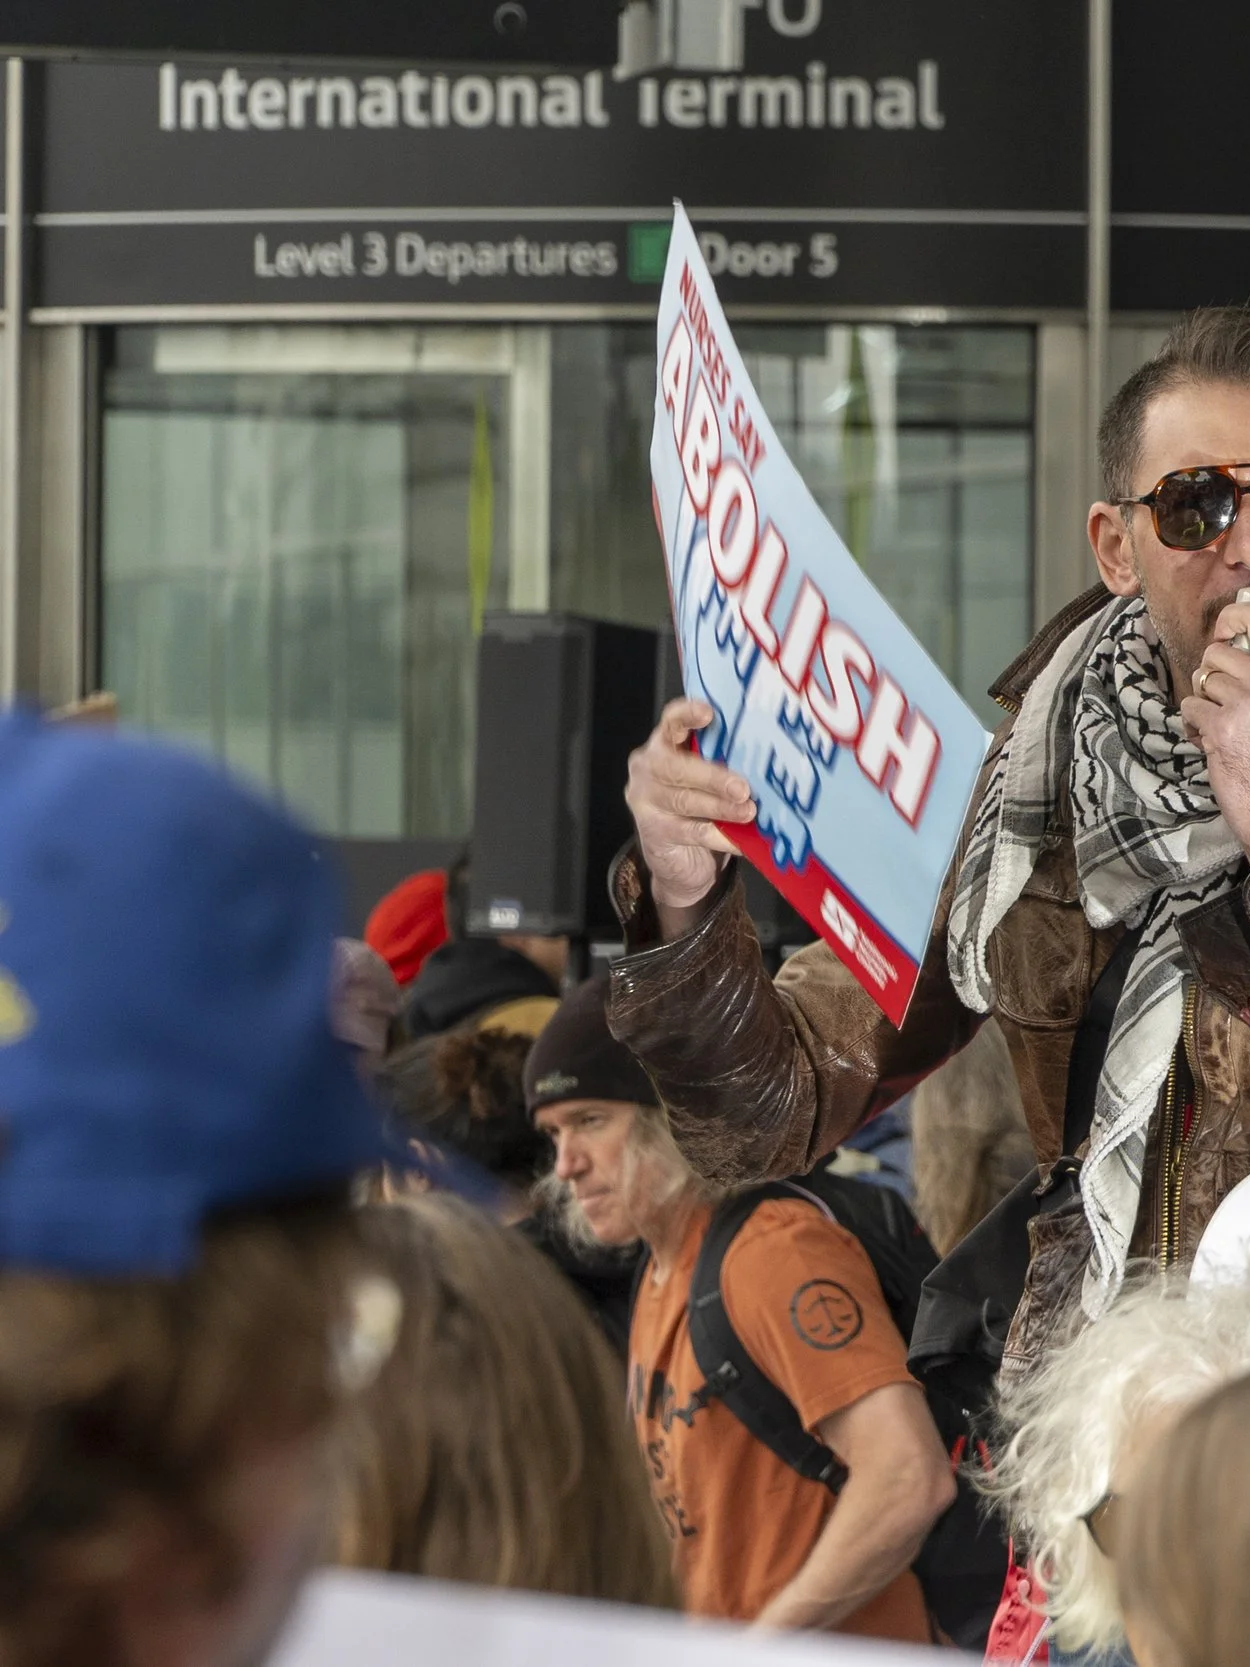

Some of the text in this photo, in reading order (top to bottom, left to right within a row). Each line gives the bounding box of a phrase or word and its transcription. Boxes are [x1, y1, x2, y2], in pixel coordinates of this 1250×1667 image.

[158, 63, 609, 132] International
[254, 231, 839, 287] Level 3 Departures Door 5
[680, 259, 767, 475] NURSES SAY
[660, 309, 942, 834] ABOLISH
